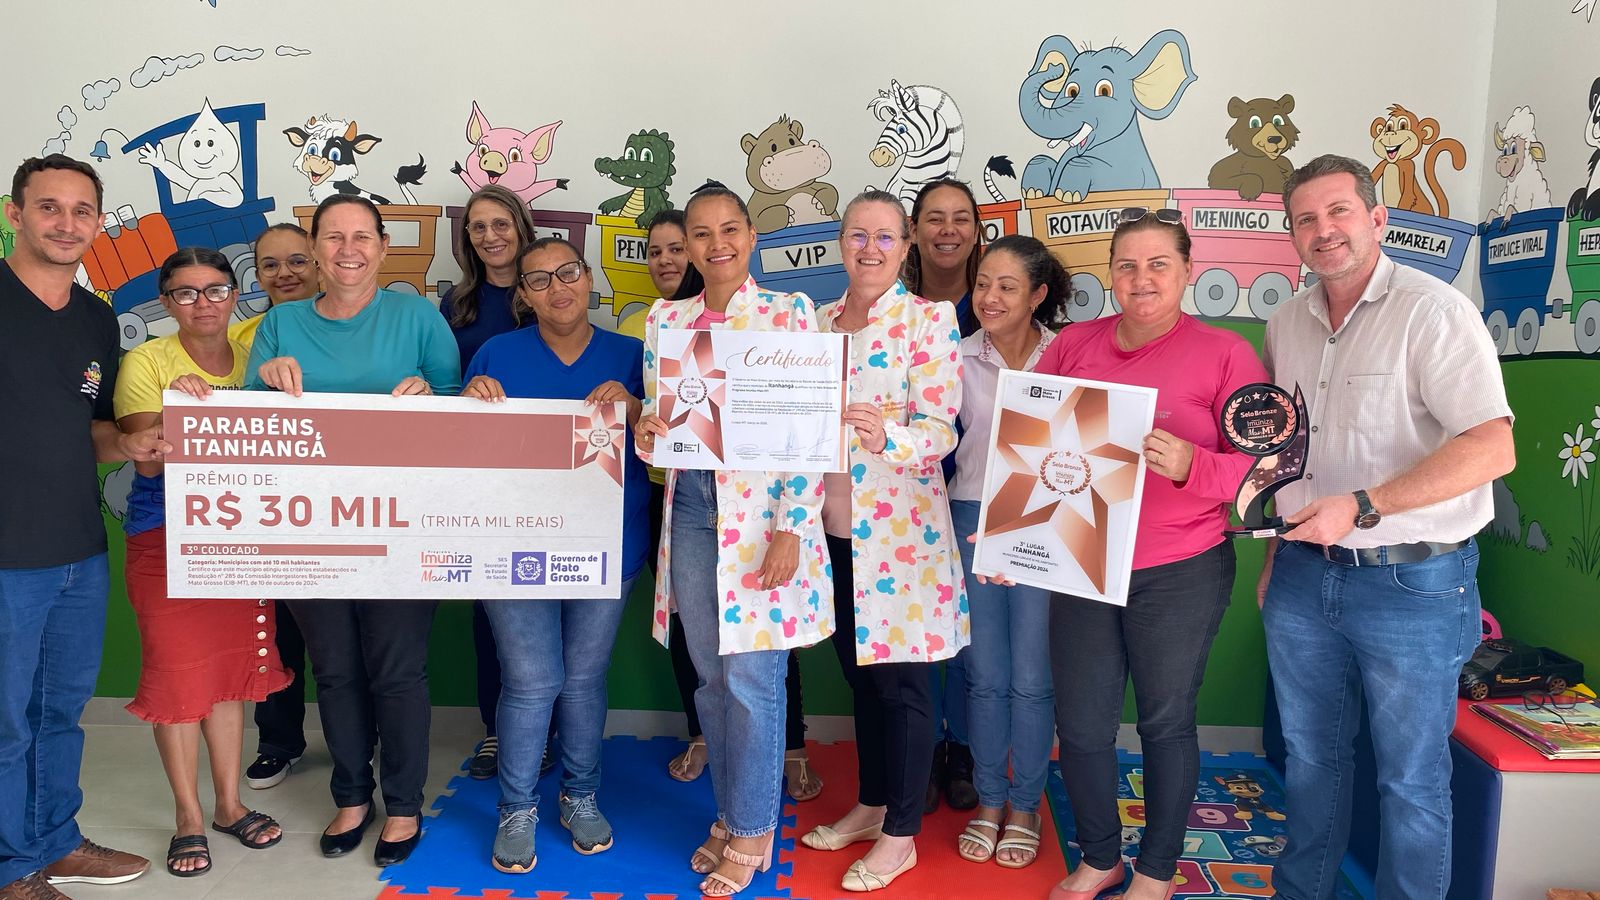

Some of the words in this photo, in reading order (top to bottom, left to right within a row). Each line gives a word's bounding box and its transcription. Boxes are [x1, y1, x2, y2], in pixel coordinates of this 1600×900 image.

[1049, 208, 1119, 236] ROTAVÍR
[1195, 210, 1269, 230] MENINGO
[617, 239, 648, 261] PEN
[1385, 230, 1446, 254] AMARELA
[1489, 240, 1521, 259] TRIPLICE
[1522, 236, 1544, 252] VIRAL
[1580, 234, 1600, 252] HEP
[785, 245, 827, 268] VIP
[726, 346, 833, 369] Certificado
[183, 413, 322, 438] PARABÉNS,
[1262, 426, 1275, 434] MT
[183, 435, 327, 458] ITANHANGÁ
[186, 470, 247, 486] PRÊMIO
[253, 473, 278, 486] DE:
[185, 491, 242, 530] R$
[258, 495, 312, 527] 30
[331, 496, 409, 528] MIL
[421, 514, 480, 529] (TRINTA
[485, 516, 511, 528] MIL
[516, 515, 564, 529] REAIS)
[201, 546, 259, 554] COLOCADO
[421, 552, 472, 564] Imuniza
[1012, 546, 1050, 558] ITANHANGÁ
[550, 563, 580, 572] Mato
[1010, 560, 1036, 570] PREMIAÇÃO
[448, 570, 472, 582] MT
[550, 573, 590, 582] Grosso
[1195, 808, 1228, 825] 9
